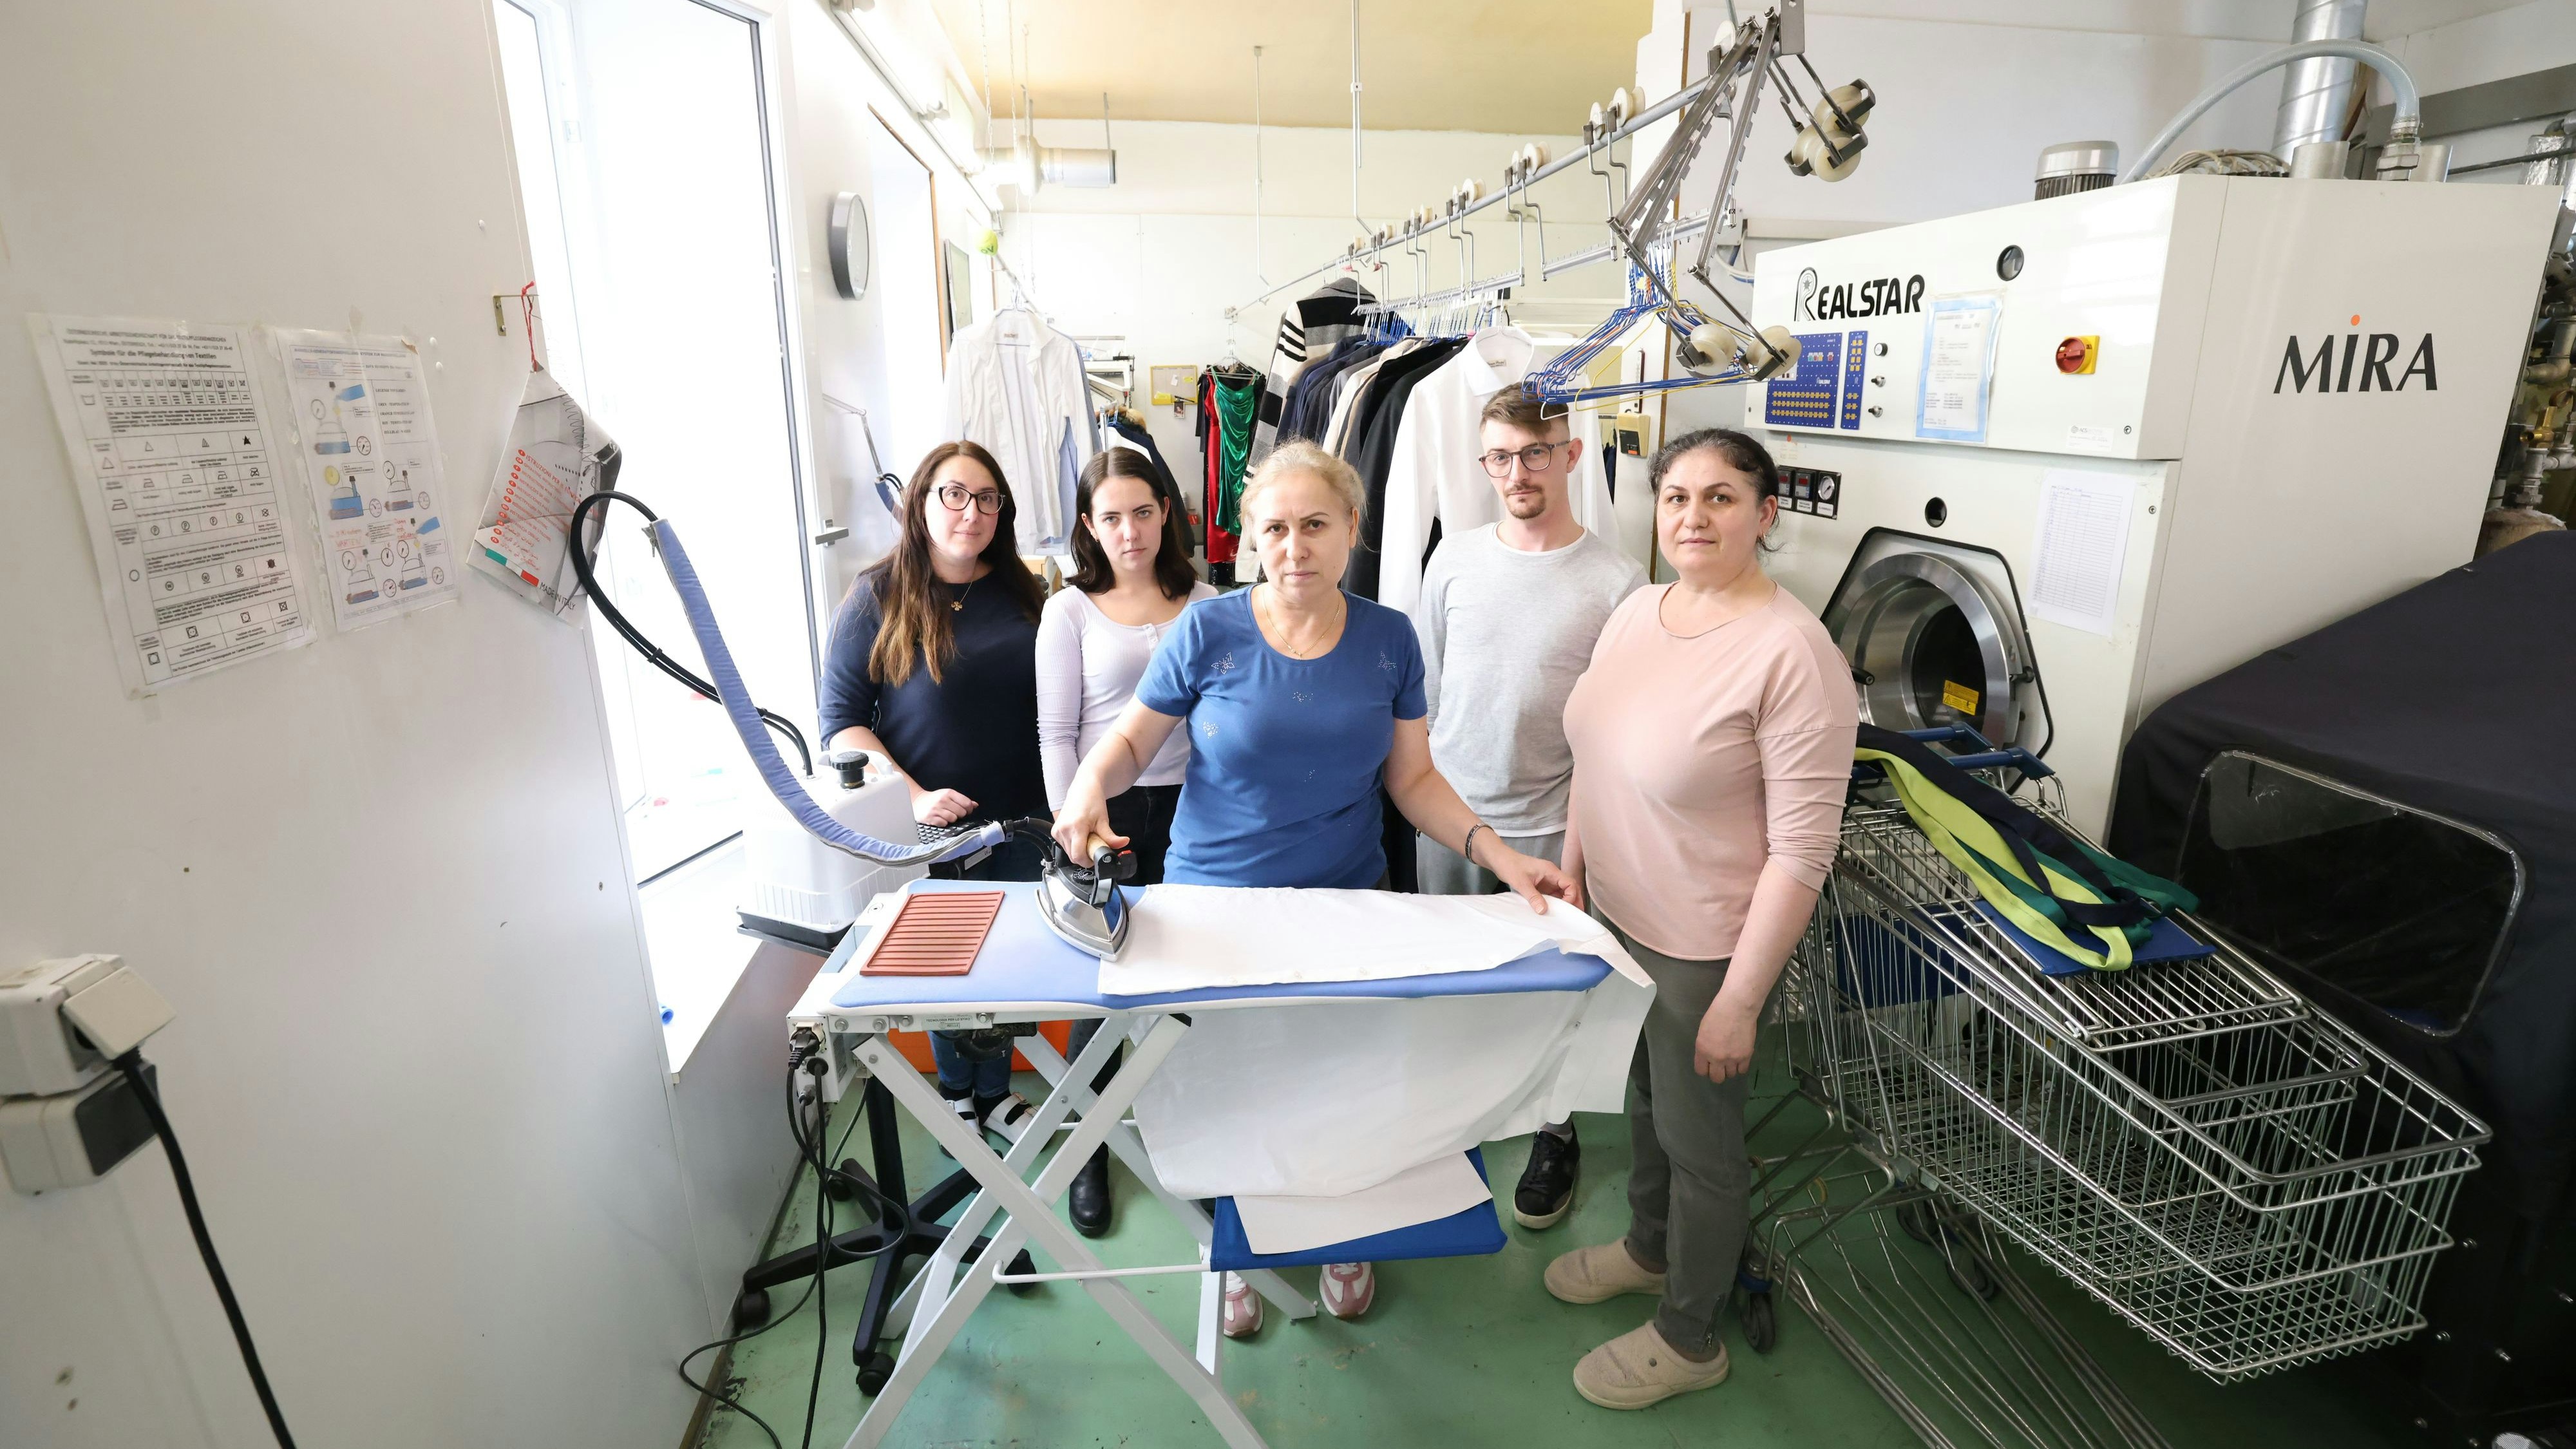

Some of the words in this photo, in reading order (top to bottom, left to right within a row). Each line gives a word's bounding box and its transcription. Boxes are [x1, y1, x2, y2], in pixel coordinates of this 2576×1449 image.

[1794, 267, 1925, 321] REALSTAR
[2273, 314, 2438, 393] MIRA
[526, 455, 551, 478] ISTRUZIONI
[540, 582, 554, 598] MADE
